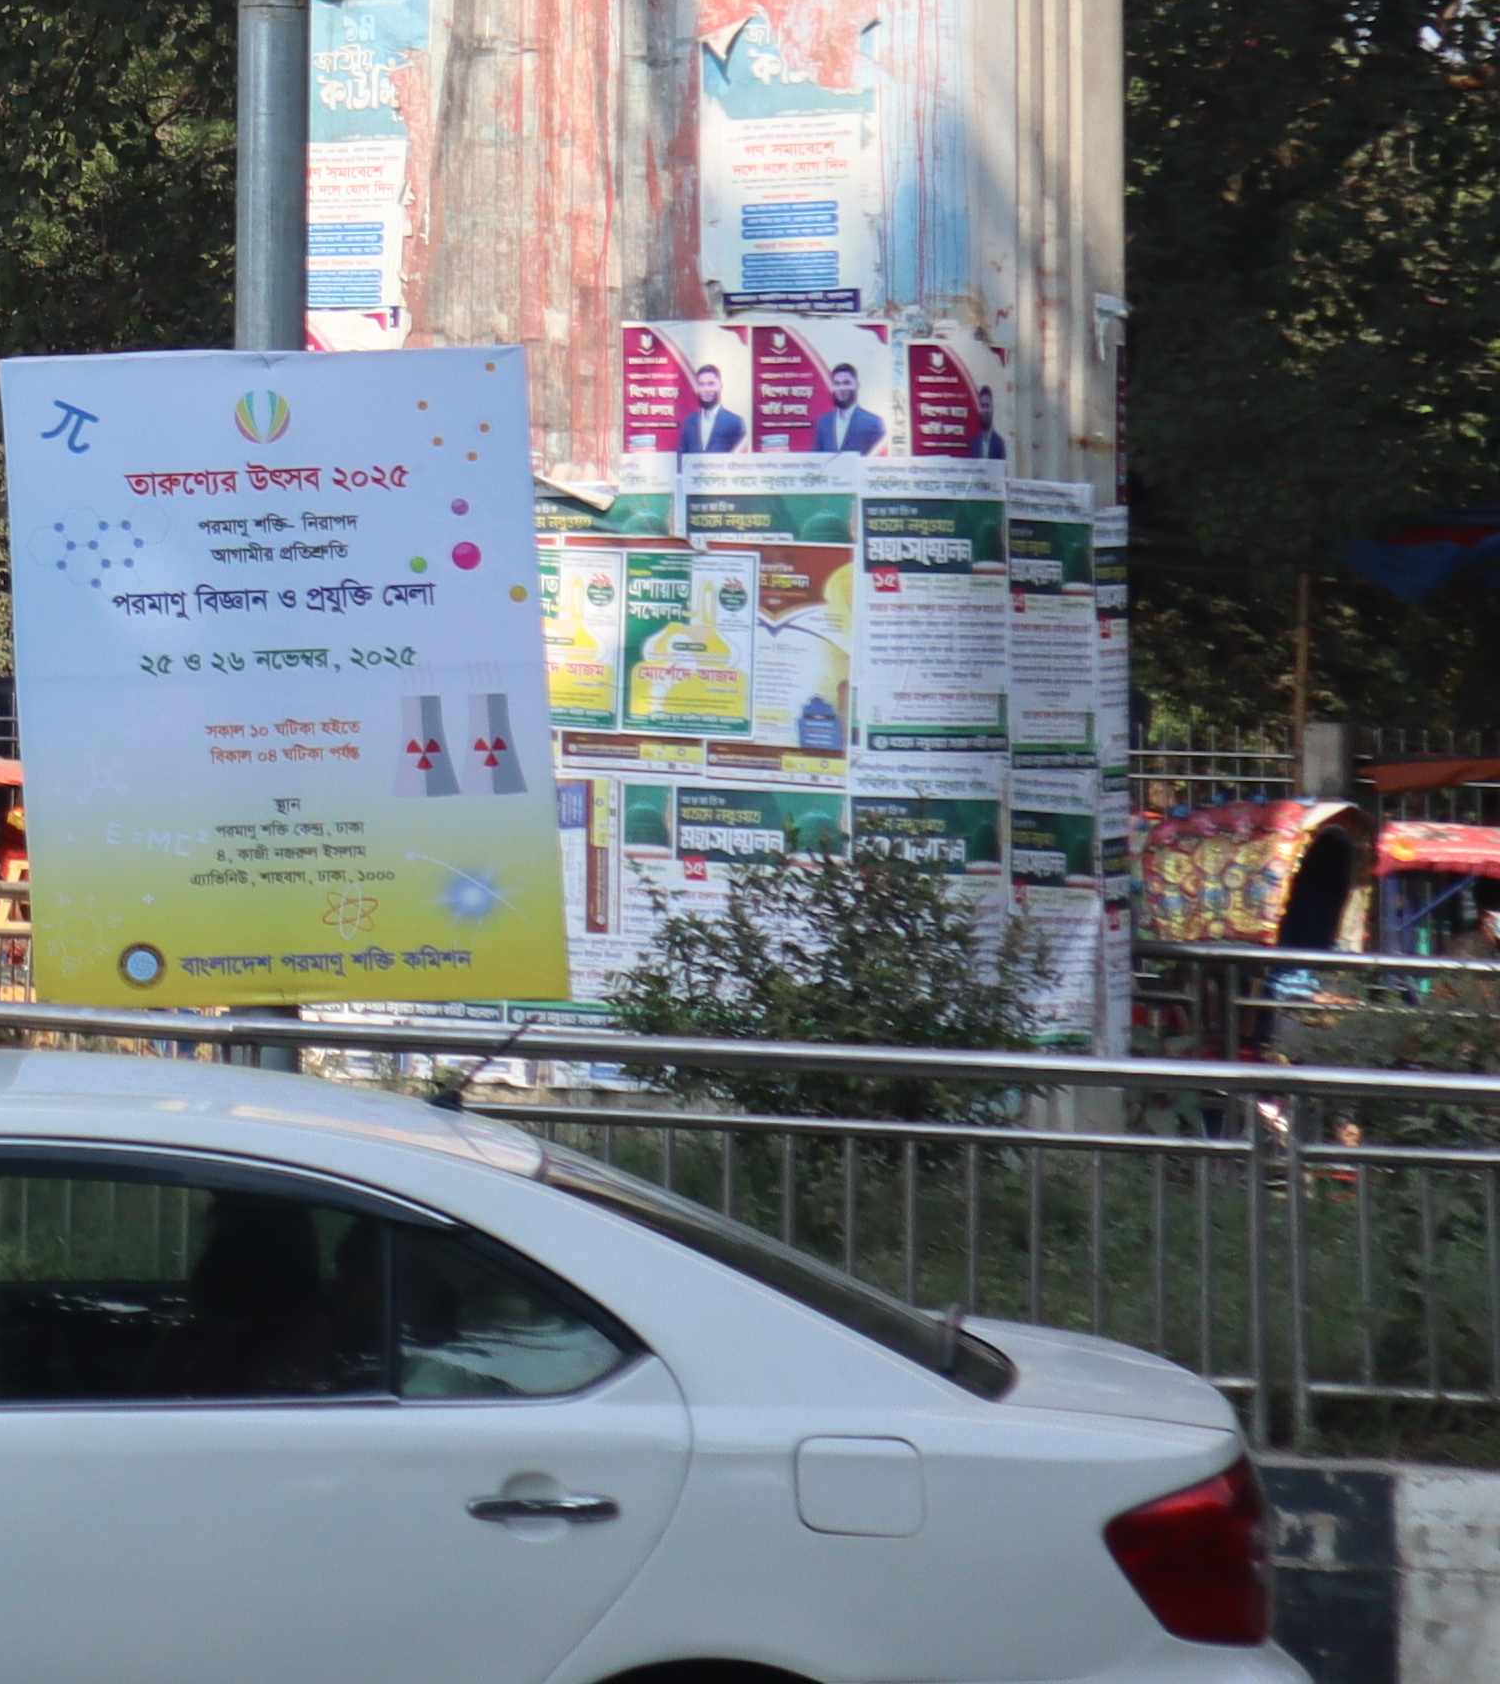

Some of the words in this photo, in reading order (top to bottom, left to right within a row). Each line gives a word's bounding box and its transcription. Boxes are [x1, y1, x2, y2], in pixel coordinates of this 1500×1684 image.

[312, 45, 377, 73] জাতীয়
[770, 141, 836, 156] সমাবেশে
[327, 165, 385, 179] সমাবেশে
[733, 164, 757, 176] দলে
[763, 162, 788, 174] দলে
[793, 161, 820, 173] যোগ
[825, 157, 849, 172] দিন
[319, 183, 341, 196] দলে
[346, 183, 370, 196] যোগ
[374, 180, 395, 195] দিন
[124, 469, 238, 497] তারুণ্যের
[246, 461, 322, 492] উৎসব
[332, 464, 409, 493] ২০২৫
[198, 517, 251, 537] পরমাণু
[301, 511, 359, 532] নিরাপদ
[210, 542, 274, 564] আগামীর
[279, 540, 350, 562] প্রতিশ্রুতি
[628, 578, 690, 600] এশায়াত
[874, 571, 897, 588] ১৫
[111, 591, 191, 620] পরমাণু
[194, 583, 270, 614] বিজ্ঞান
[277, 589, 297, 609] ও
[306, 578, 374, 615] প্রযুক্তি
[382, 582, 437, 607] মেলা
[139, 654, 173, 678] ২৫
[182, 653, 201, 671] ও
[210, 652, 245, 676] ২৬
[350, 645, 418, 670] ২০২৫
[205, 724, 245, 739] সকাল
[250, 724, 269, 738] ১০
[275, 718, 316, 736] ঘটিকা
[320, 718, 362, 734] হইতে
[210, 747, 253, 765] বিকাল
[257, 749, 278, 764] ০৪
[283, 745, 324, 763] ঘটিকা
[329, 743, 361, 761] পর্যন্ত
[274, 798, 301, 815] স্থান
[215, 823, 258, 842] পরমাণু
[260, 821, 290, 837] শক্তি
[335, 820, 365, 835] ঢাকা
[237, 845, 270, 863] কাজী
[321, 843, 367, 860] ইসলাম
[357, 870, 396, 883] ১০০০
[179, 954, 272, 977] বাংলাদেশ
[280, 953, 347, 977] পরমাণু
[352, 946, 396, 971] শক্তি
[402, 944, 473, 970] কমিশন
